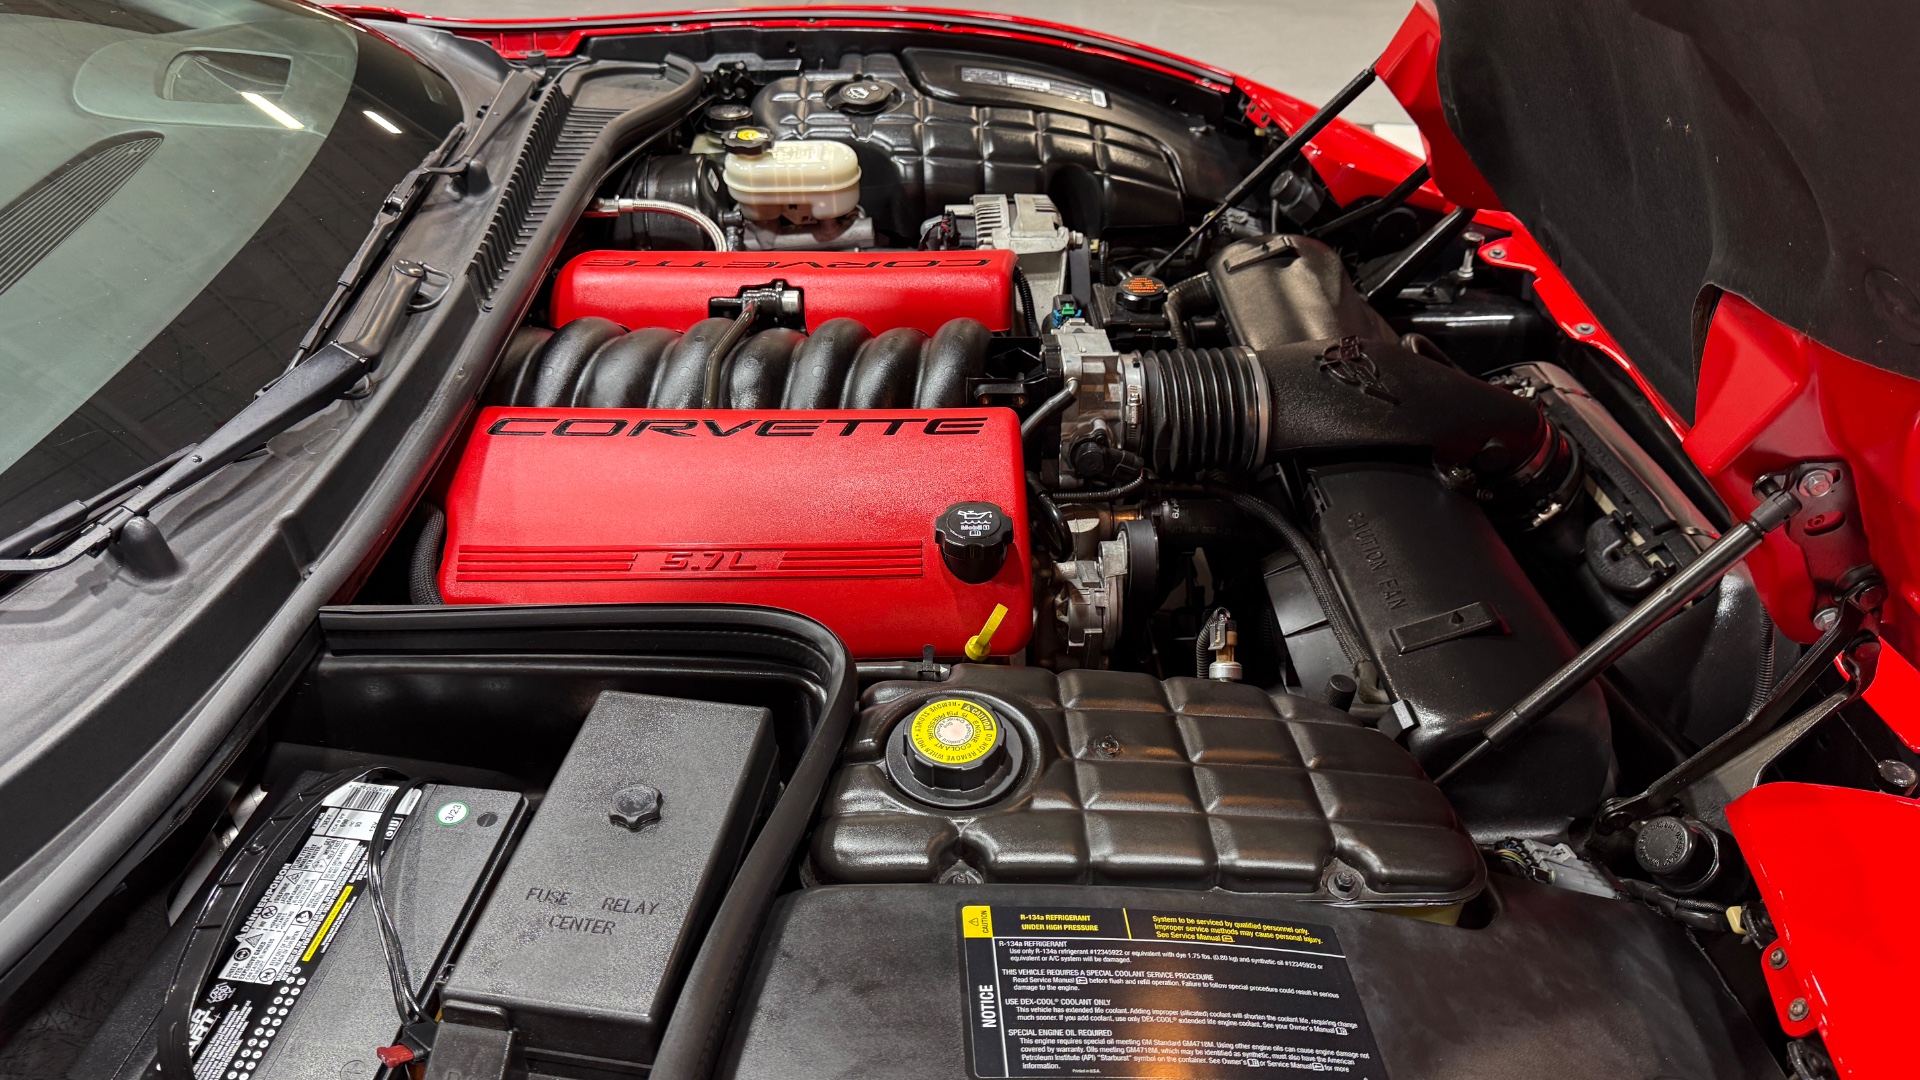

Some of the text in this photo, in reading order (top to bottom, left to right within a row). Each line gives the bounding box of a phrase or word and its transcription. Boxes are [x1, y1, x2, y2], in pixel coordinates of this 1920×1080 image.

[581, 258, 991, 269] CORVETTE
[488, 417, 988, 438] CORVETTE
[660, 551, 757, 571] 5.7L
[1348, 512, 1409, 610] CAUTION FAN
[915, 701, 957, 732] REMOVE SLOWLY
[927, 713, 946, 740] PRESSURE
[972, 706, 993, 731] CAUTION
[934, 720, 981, 751] ENGINE COOLANT
[924, 747, 944, 760] WHEN
[946, 751, 977, 761] REMOVE
[977, 742, 989, 753] NOT
[319, 814, 333, 828] 75EXT
[445, 805, 461, 821] 3/23
[240, 863, 292, 932] DANGER/POISON
[525, 888, 660, 915] FUSE RELAY
[549, 914, 616, 936] CENTER
[1153, 915, 1177, 923] System
[1197, 918, 1224, 926] serviced
[1234, 922, 1261, 930] qualified
[1263, 924, 1293, 932] personnel
[1295, 927, 1309, 935] only.
[1211, 927, 1239, 935] methods
[1275, 933, 1302, 941] personal
[1146, 971, 1174, 979] SERVICE
[1175, 972, 1213, 980] PROCEDURE
[978, 984, 997, 1028] NOTICE
[1216, 1042, 1233, 1050] Using
